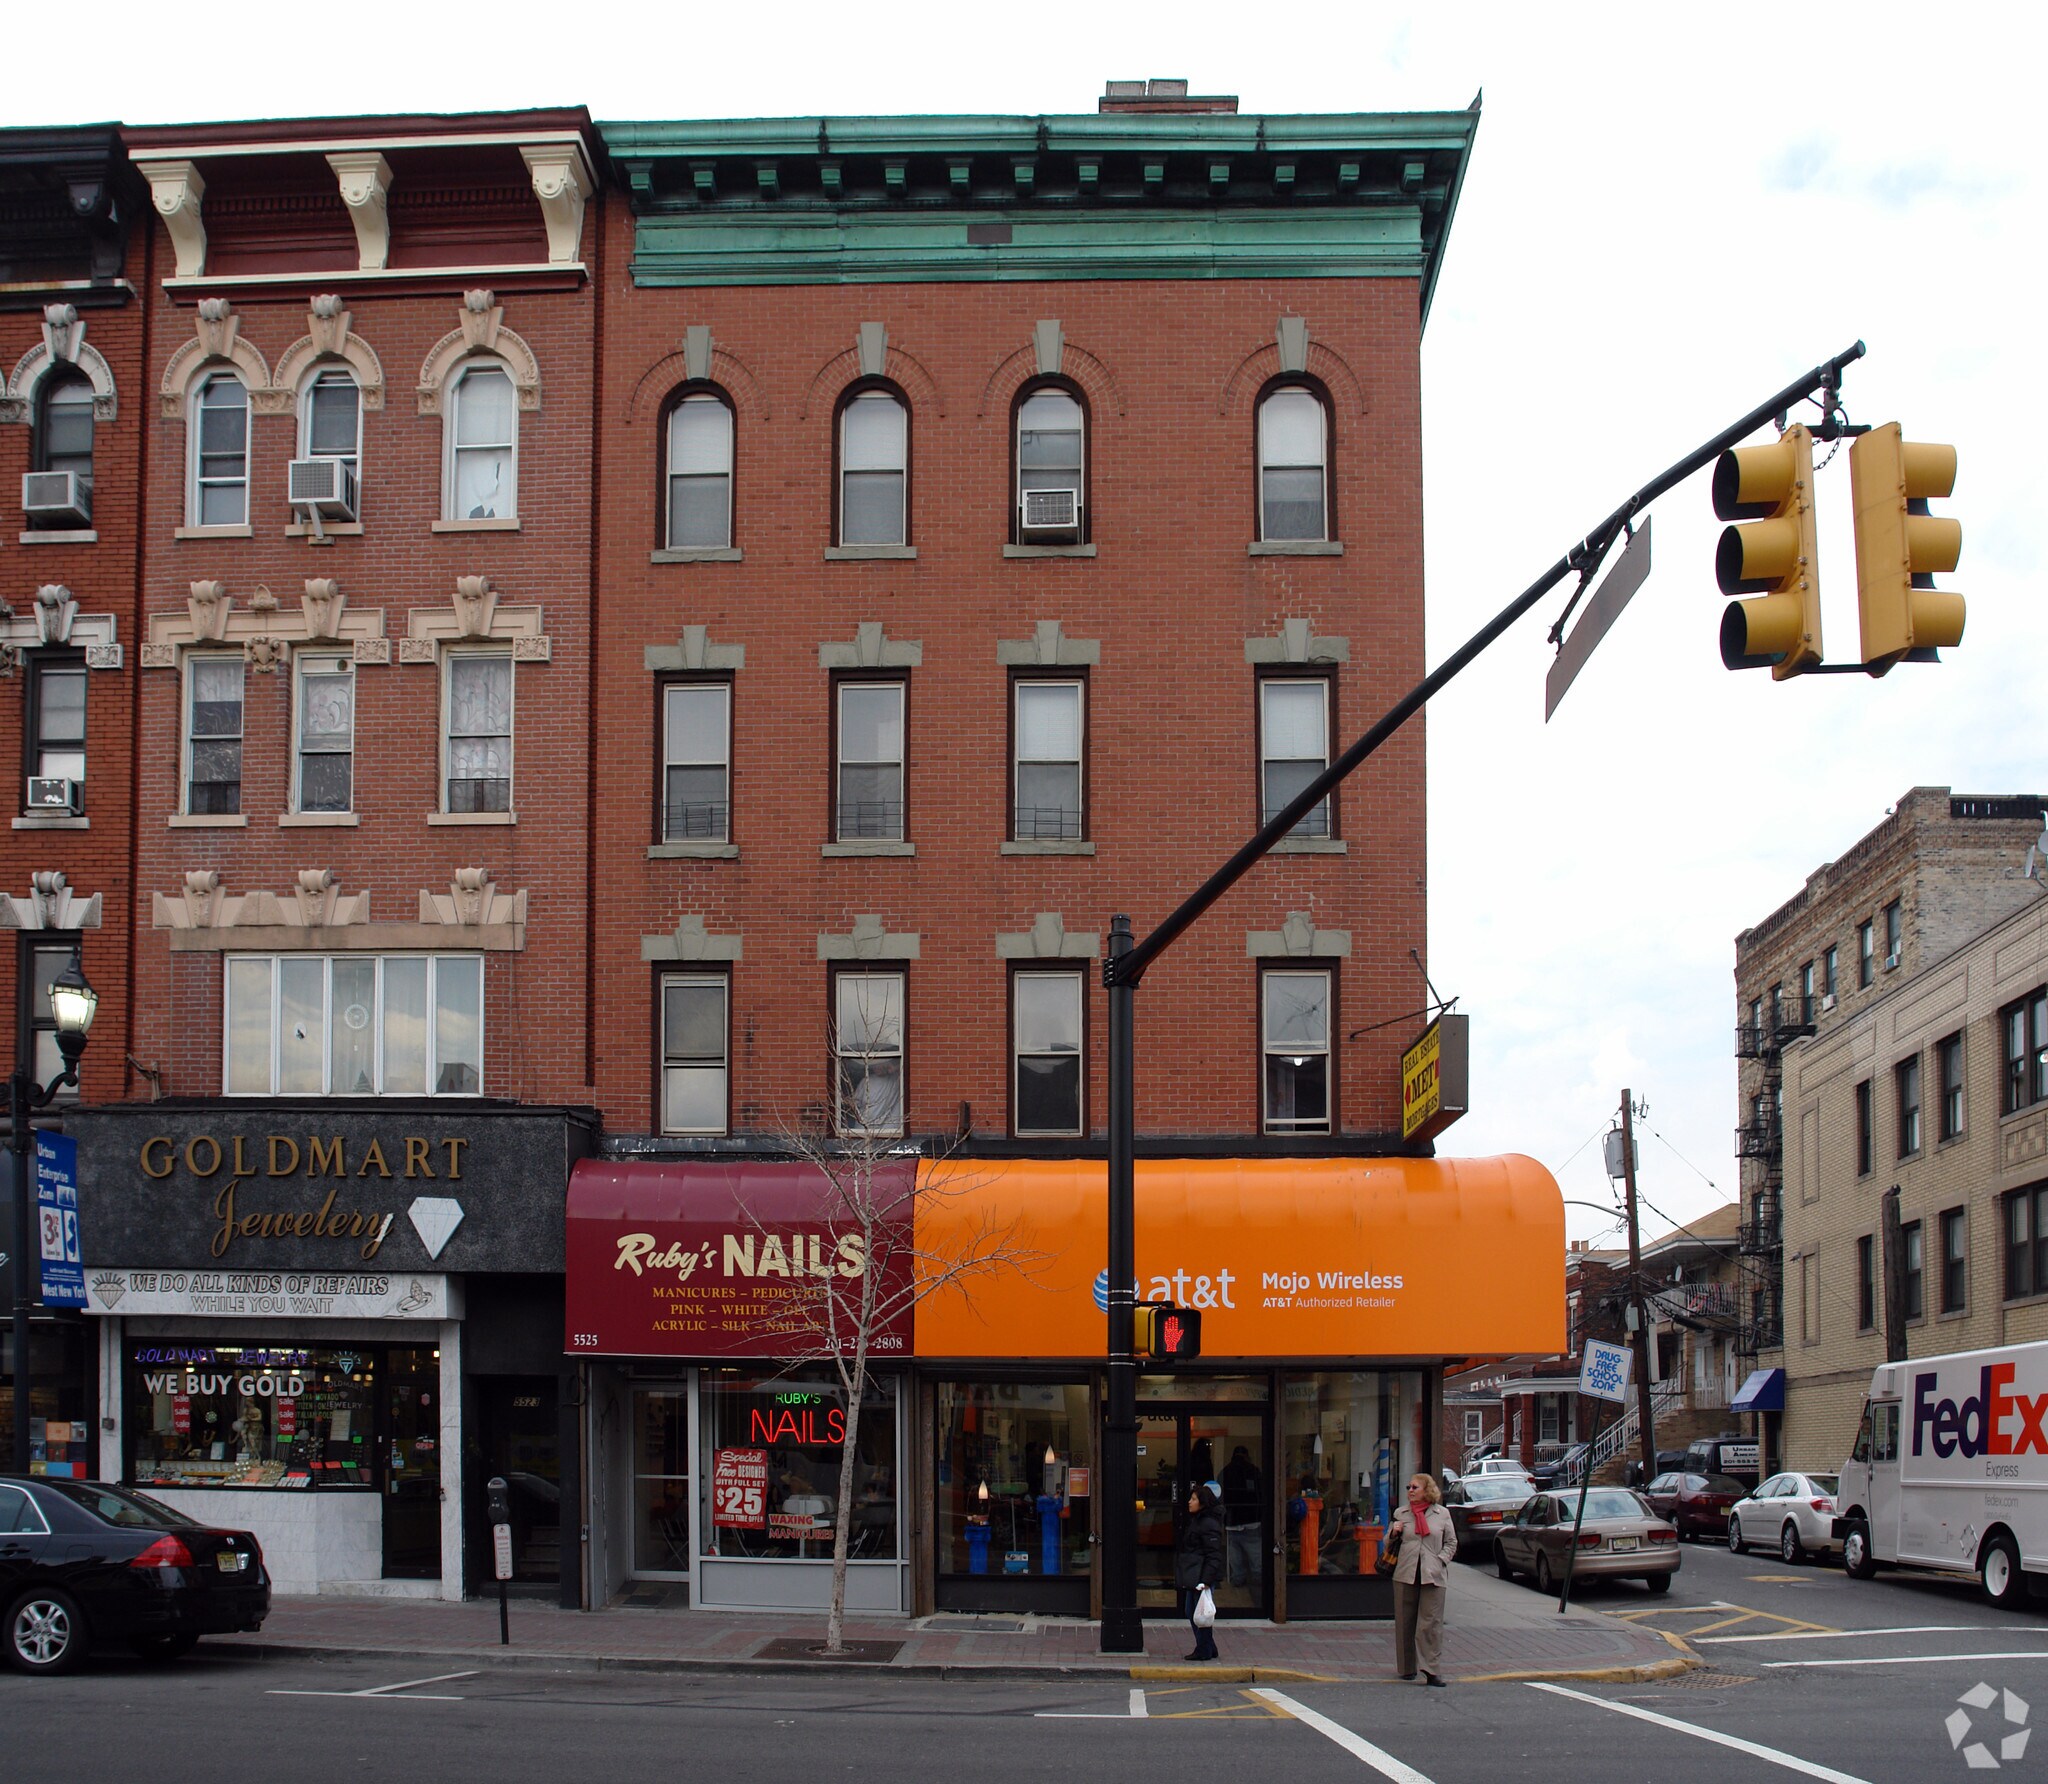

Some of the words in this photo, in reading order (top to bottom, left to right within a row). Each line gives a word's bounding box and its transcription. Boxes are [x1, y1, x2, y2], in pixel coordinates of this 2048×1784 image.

[1404, 1051, 1420, 1075] REAL
[1411, 1061, 1435, 1104] MET
[1405, 1093, 1438, 1132] MORTGAGES
[37, 1143, 56, 1160] Urban
[140, 1135, 469, 1179] GOLDMART
[37, 1164, 69, 1183] Enterprise
[211, 1179, 394, 1260] Jewelery
[614, 1233, 718, 1282] Ruby's
[723, 1234, 866, 1278] NAILS
[41, 1282, 59, 1297] West
[58, 1283, 73, 1298] New
[128, 1274, 157, 1293] WE
[160, 1274, 188, 1293] DO
[189, 1274, 224, 1294] ALL
[226, 1276, 283, 1295] KINDS
[285, 1276, 311, 1295] OF
[311, 1276, 389, 1296] REPAIRS
[1147, 1268, 1236, 1309] at&t
[1262, 1271, 1311, 1294] Mojo
[1317, 1271, 1404, 1291] Wireless
[652, 1287, 737, 1299] MANICURES
[190, 1296, 246, 1313] WHILE
[248, 1296, 287, 1313] YOU
[288, 1297, 334, 1314] WAIT
[1262, 1296, 1293, 1308] AT&T
[1295, 1296, 1354, 1308] Authorized
[1356, 1296, 1396, 1308] Retailer
[670, 1304, 705, 1316] PINK
[721, 1304, 768, 1316] WHITE
[783, 1305, 810, 1316] GEL
[652, 1320, 708, 1332] ACRYLIC
[721, 1320, 751, 1332] SILK
[766, 1320, 798, 1332] NAIL
[573, 1334, 598, 1346] 5525
[825, 1337, 903, 1350] 21-2-2808
[1595, 1349, 1624, 1364] DRUG-
[1595, 1360, 1618, 1373] FREE
[1587, 1367, 1624, 1385] SCHOOL
[143, 1373, 179, 1395] WE
[186, 1374, 233, 1396] BUY
[238, 1374, 305, 1398] GOLD
[1590, 1378, 1617, 1393] ZONE
[174, 1395, 190, 1403] sale
[278, 1397, 294, 1406] sale
[515, 1397, 540, 1406] 5523
[775, 1392, 822, 1405] RUBY'S
[174, 1407, 190, 1416] sale
[278, 1410, 294, 1419] sale
[1912, 1362, 2048, 1459] FedEx
[175, 1420, 190, 1429] sale
[279, 1423, 294, 1432] sale
[751, 1408, 845, 1444] NAILS
[720, 1450, 763, 1464] Special
[715, 1462, 737, 1478] Free
[737, 1464, 766, 1479] DESIGNER
[1985, 1460, 2019, 1480] Express
[715, 1478, 734, 1486] WITH
[733, 1479, 751, 1487] FULL
[752, 1480, 765, 1488] SET
[716, 1487, 763, 1516] $25
[1984, 1493, 2019, 1508] fedex.com
[714, 1513, 735, 1522] LIMITED
[735, 1514, 748, 1523] TIME
[749, 1515, 764, 1523] OFFER
[769, 1514, 814, 1525] WAXING
[768, 1528, 835, 1540] MANICURES
